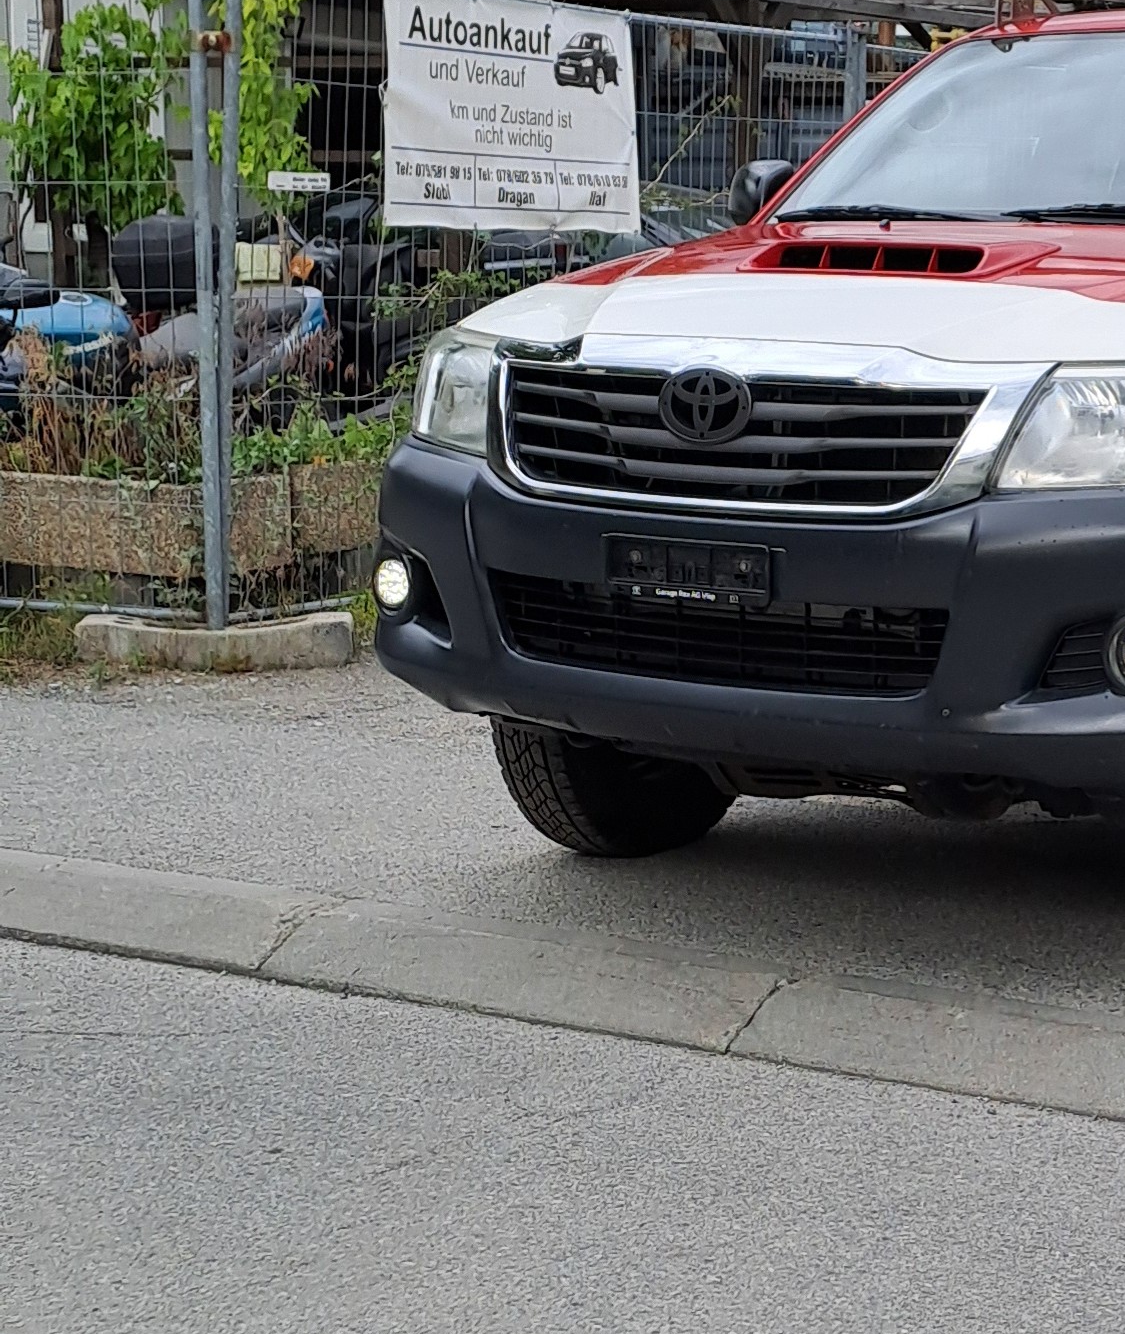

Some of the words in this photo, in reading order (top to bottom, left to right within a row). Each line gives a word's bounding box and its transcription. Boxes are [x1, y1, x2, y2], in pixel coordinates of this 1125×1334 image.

[408, 5, 551, 55] Autoankauf
[429, 58, 459, 82] und
[465, 59, 526, 87] Verkauf
[449, 99, 469, 120] km
[473, 103, 496, 122] und
[501, 104, 553, 127] Zustand
[558, 109, 572, 129] ist
[475, 124, 504, 145] nicht
[507, 127, 553, 153] wichtig
[395, 161, 412, 176] Tel:
[478, 167, 493, 181] Tel:
[559, 172, 574, 186] Tel:
[498, 187, 535, 207] Dragan
